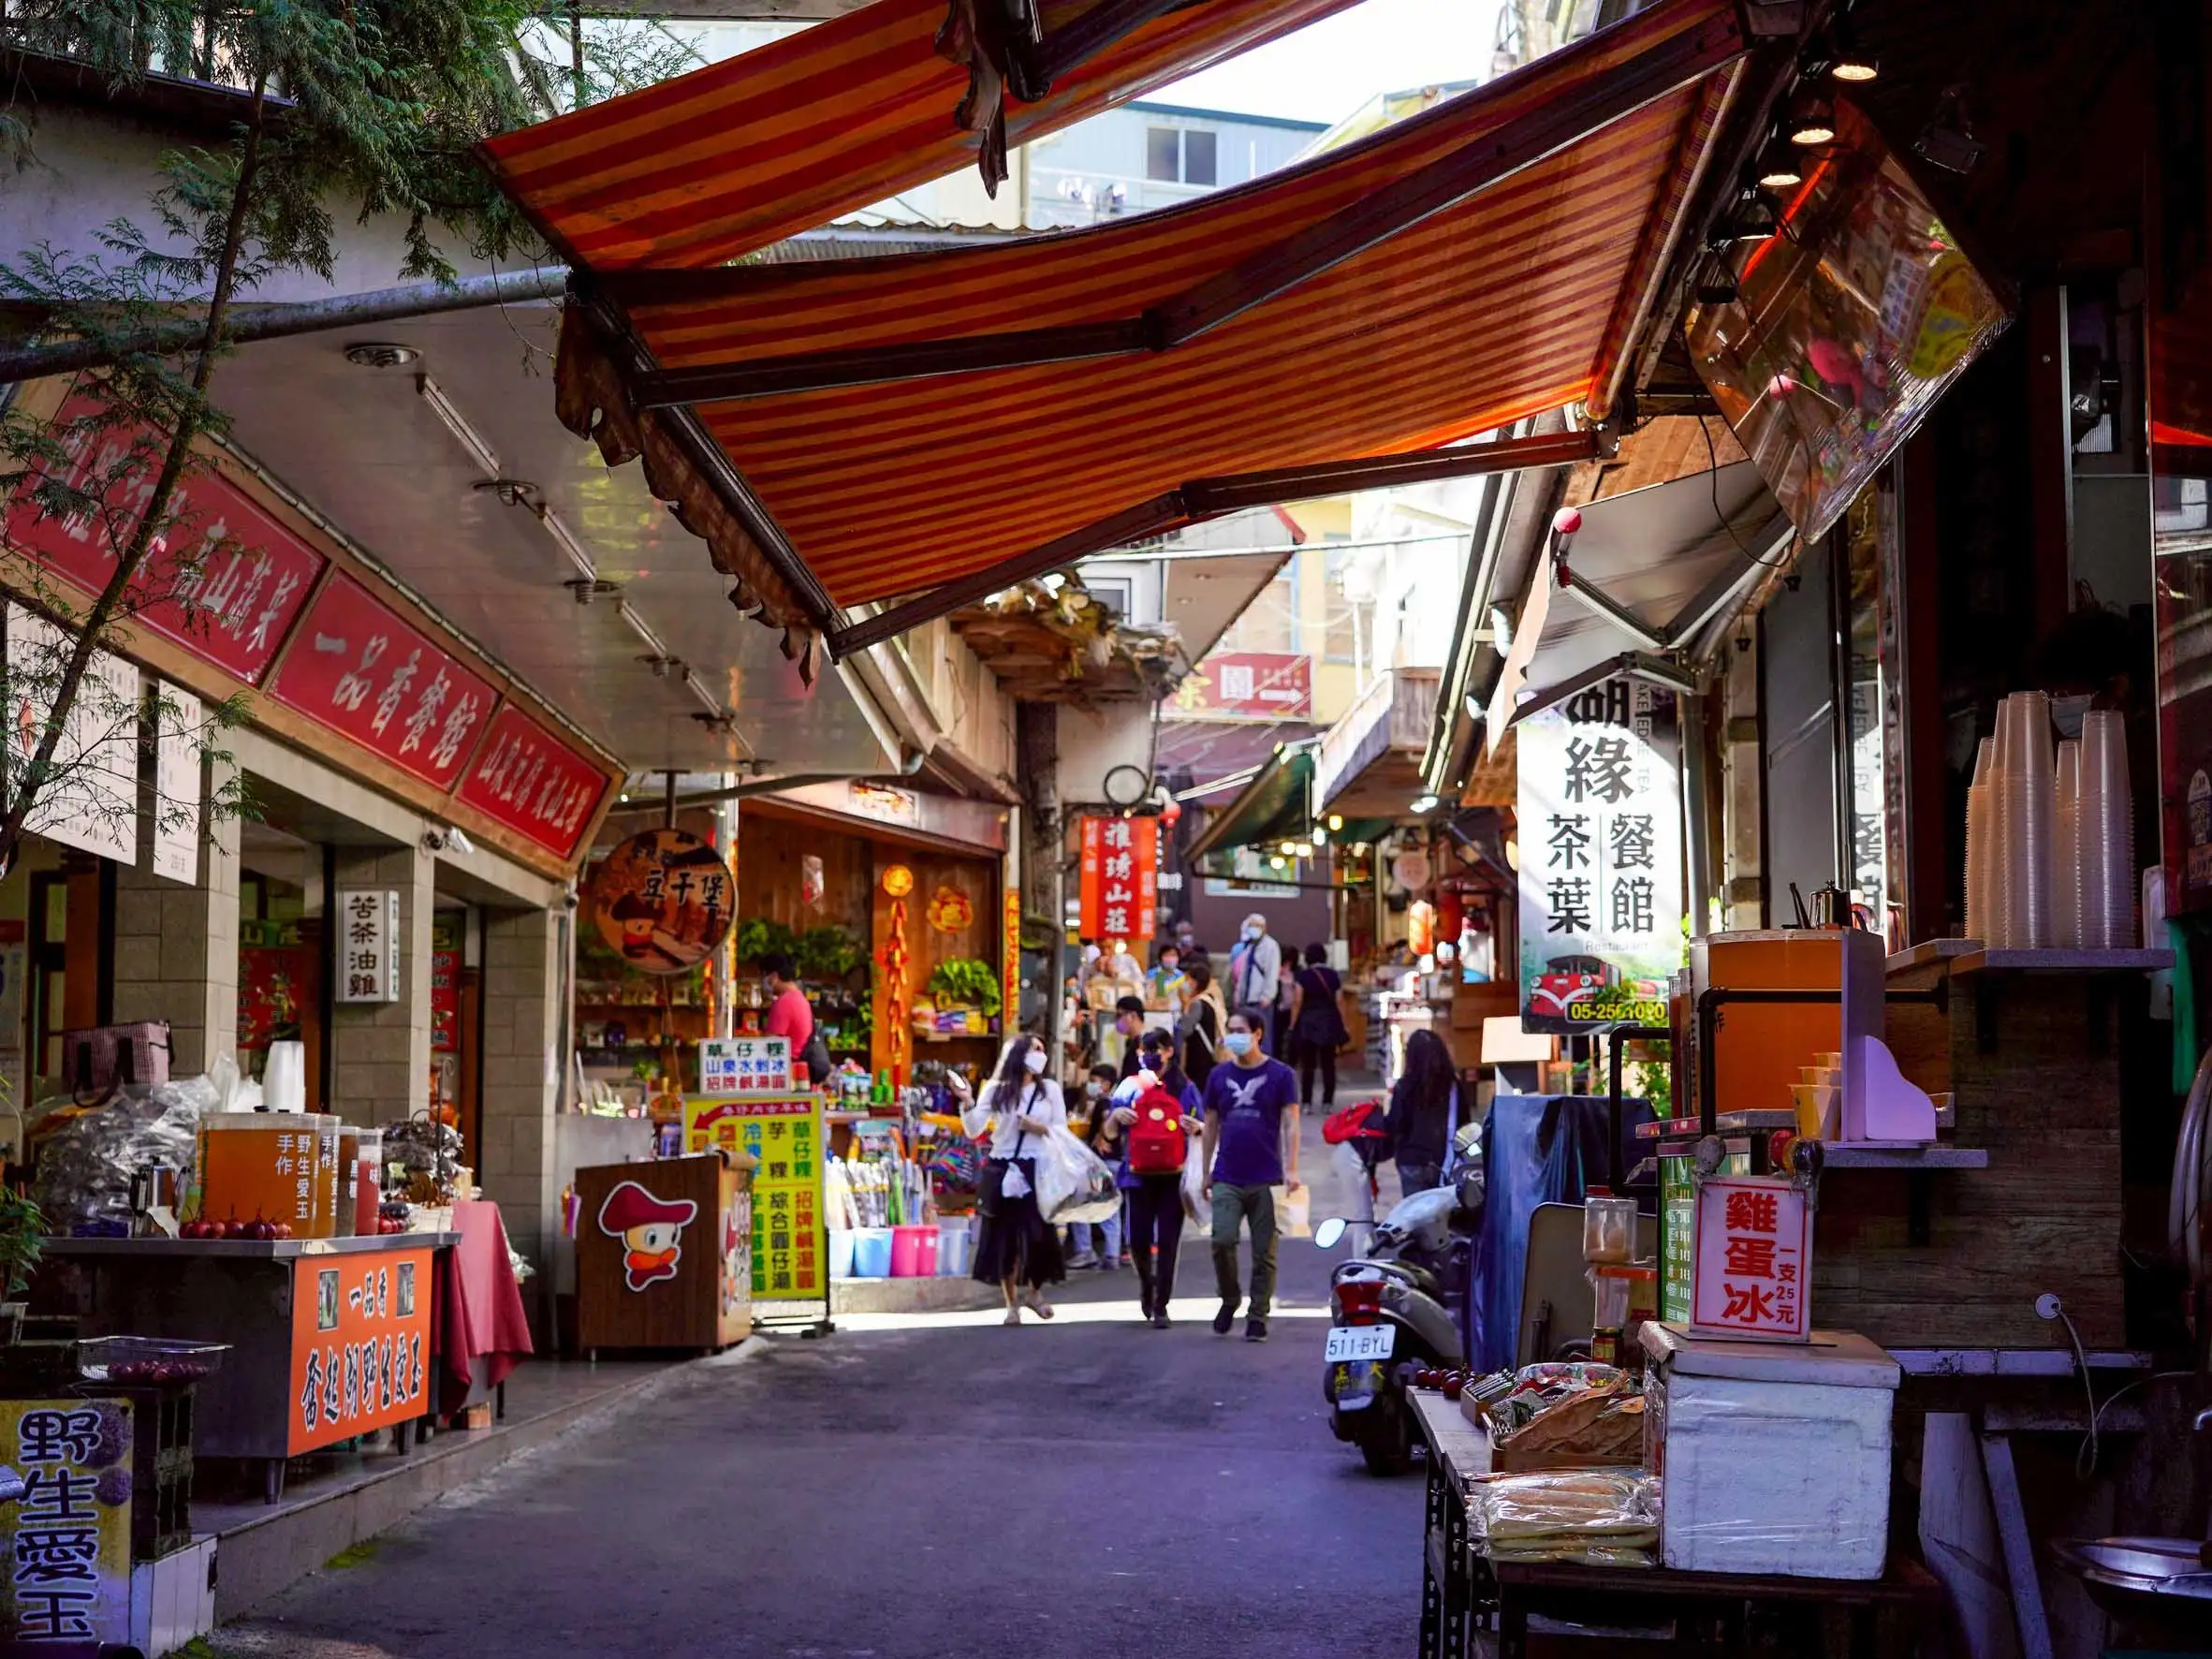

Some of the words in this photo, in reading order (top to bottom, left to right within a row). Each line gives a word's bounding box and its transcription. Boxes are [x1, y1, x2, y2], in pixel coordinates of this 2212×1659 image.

[313, 631, 478, 771] 一品香餐館
[638, 868, 725, 910] 豆干堡
[1545, 813, 1591, 934] 茶葉
[1609, 812, 1655, 934] 餐館
[348, 894, 380, 999] 苦茶油雞
[275, 1133, 295, 1177] 手作
[295, 1133, 312, 1220] 野生愛玉
[348, 1266, 388, 1320] 一品香
[1721, 1190, 1779, 1324] 雞蛋冰
[1327, 1337, 1390, 1357] 511-BYL
[15, 1408, 102, 1643] 野生愛玉
